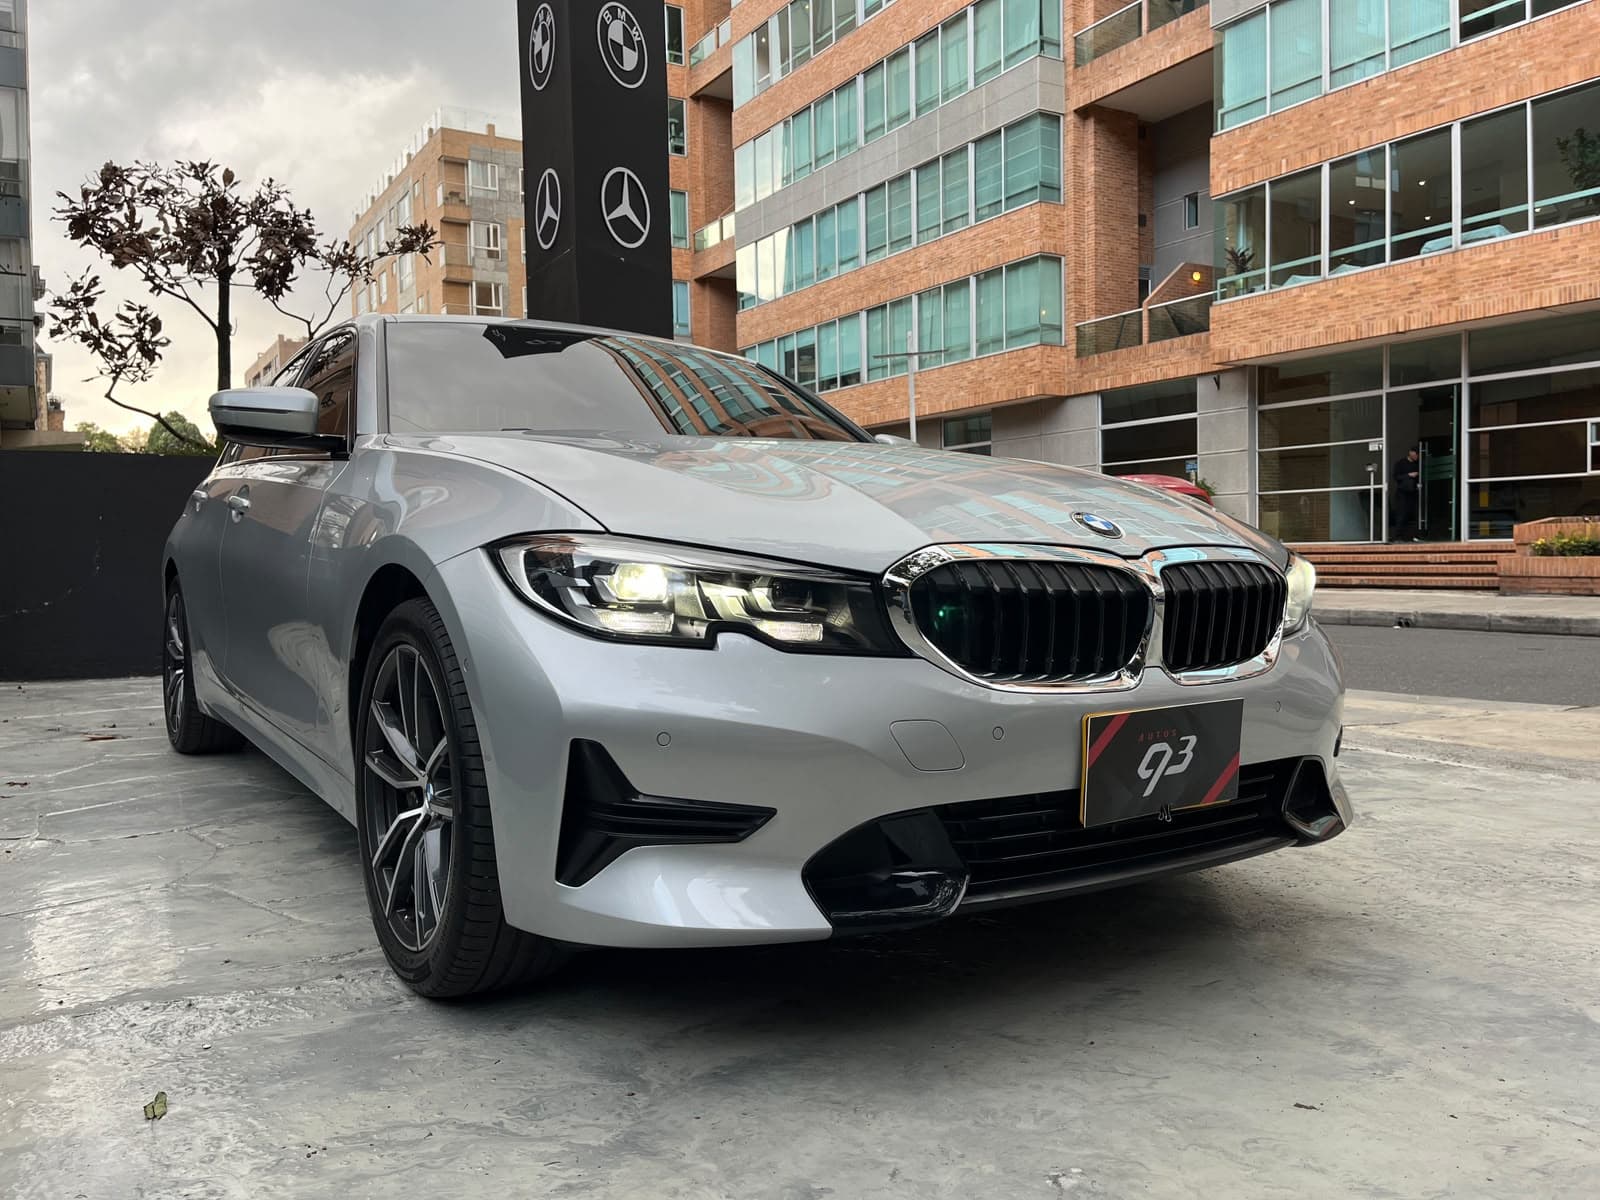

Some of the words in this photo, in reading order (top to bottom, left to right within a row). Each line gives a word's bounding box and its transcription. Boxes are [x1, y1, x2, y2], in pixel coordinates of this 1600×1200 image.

[602, 8, 641, 41] BMW
[1138, 729, 1177, 743] AUTOS
[1137, 735, 1197, 797] 93
